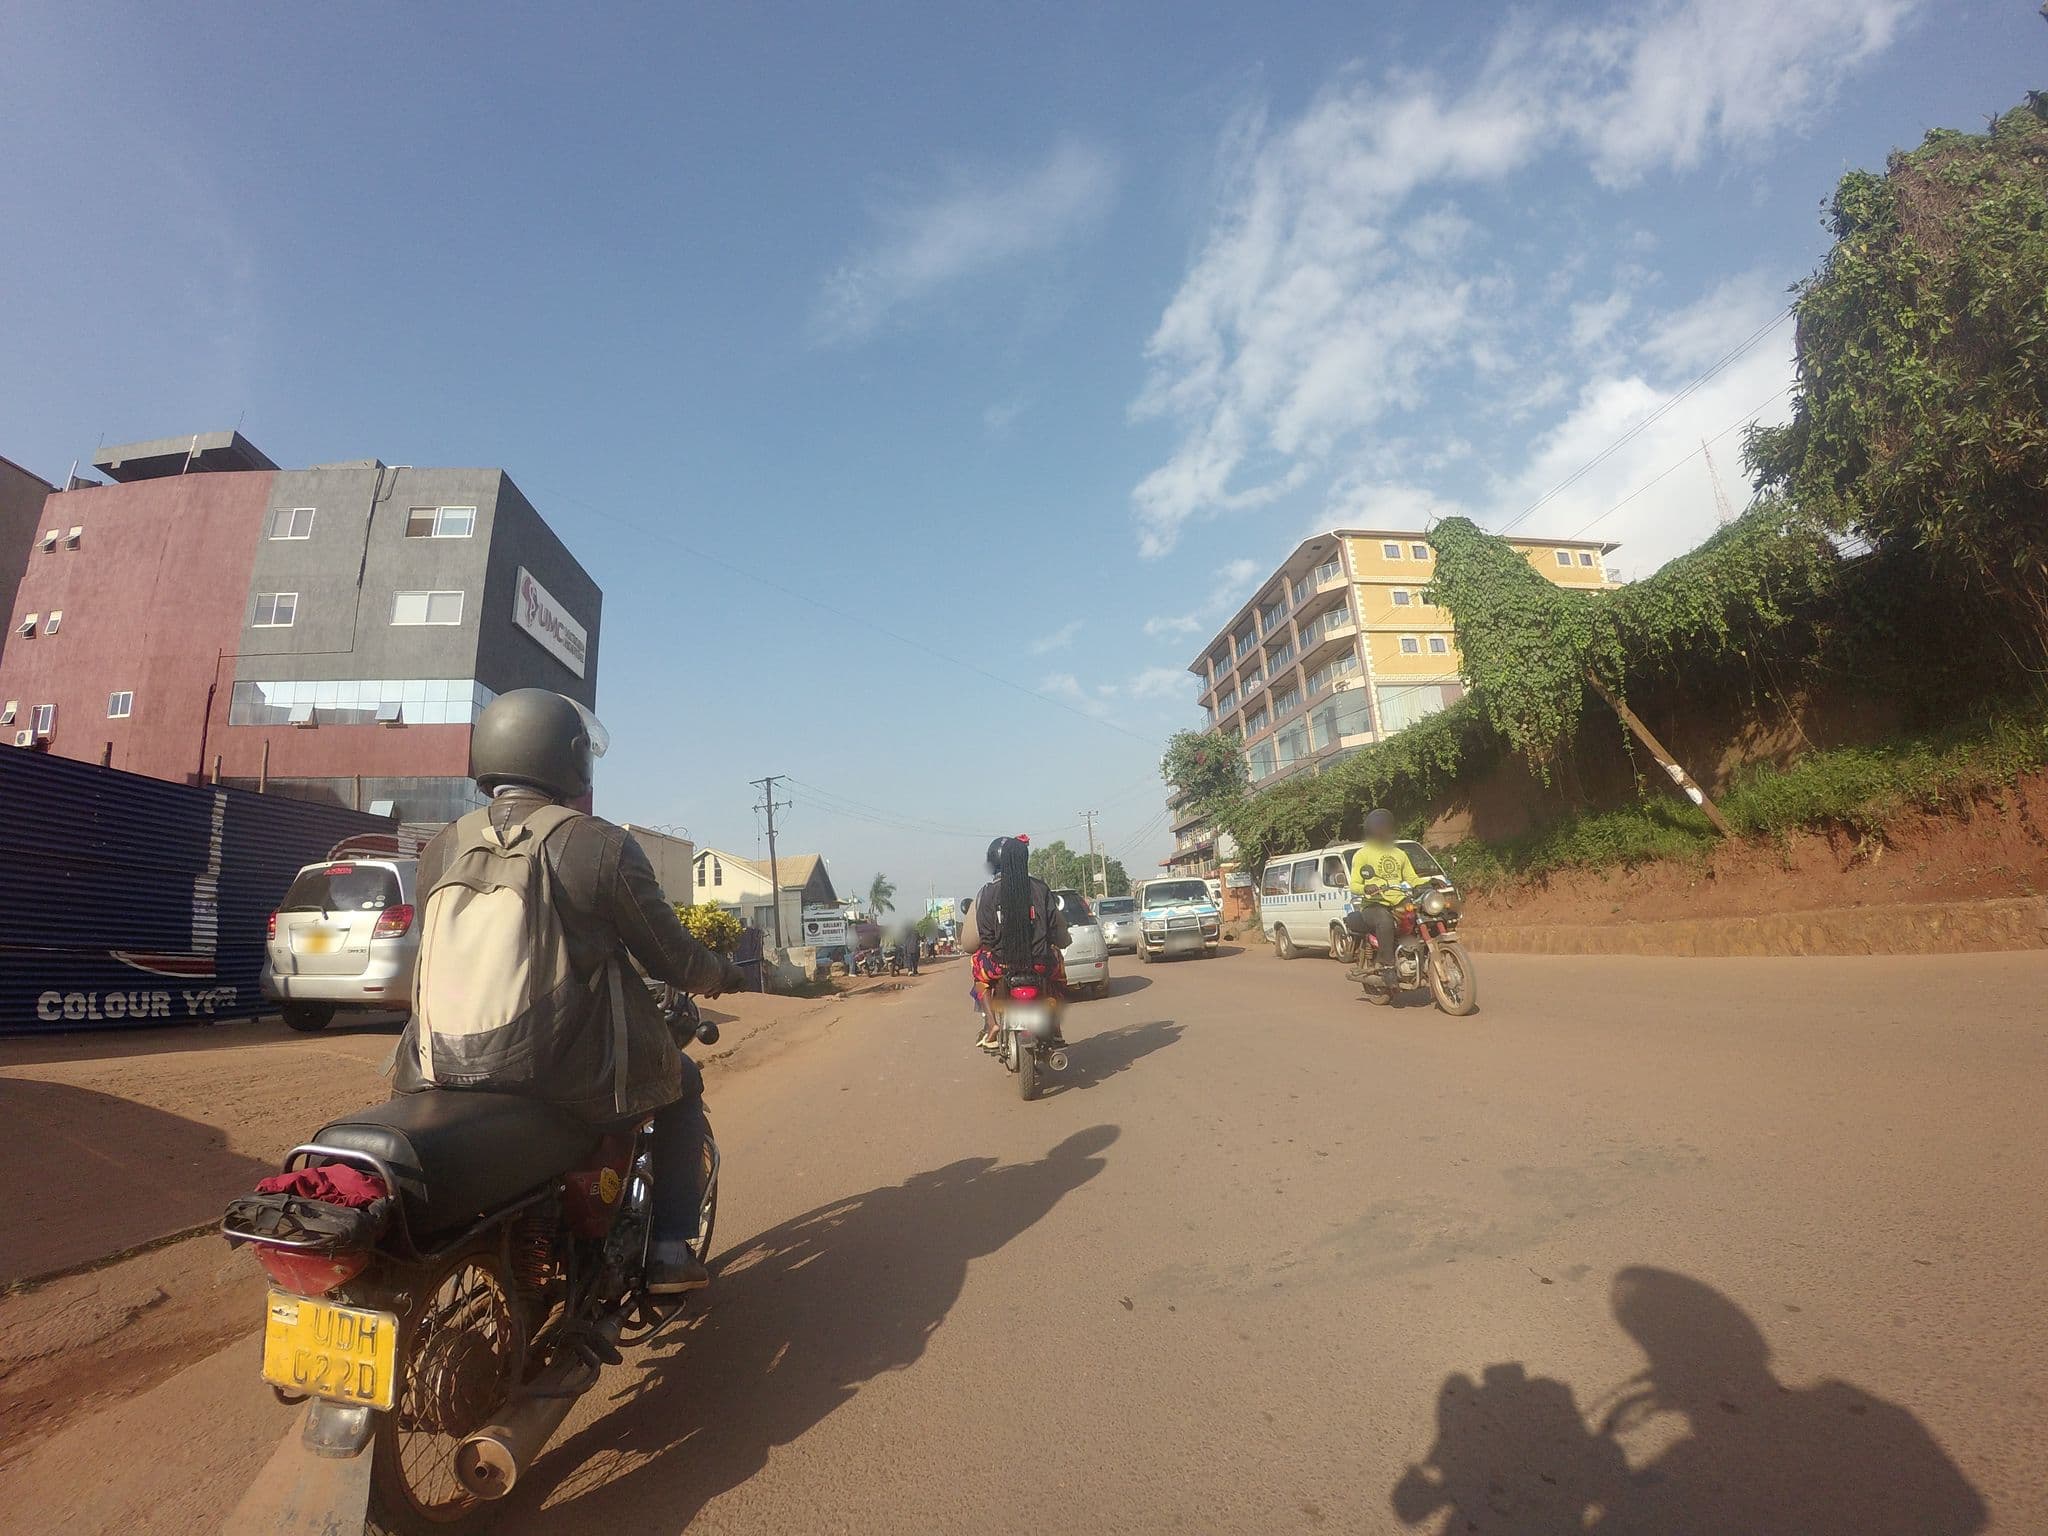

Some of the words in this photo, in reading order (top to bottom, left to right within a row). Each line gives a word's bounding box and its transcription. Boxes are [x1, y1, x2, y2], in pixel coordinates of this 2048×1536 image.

[538, 603, 565, 642] UMC
[37, 990, 171, 1021] COLOUR
[312, 1307, 379, 1356] UDH
